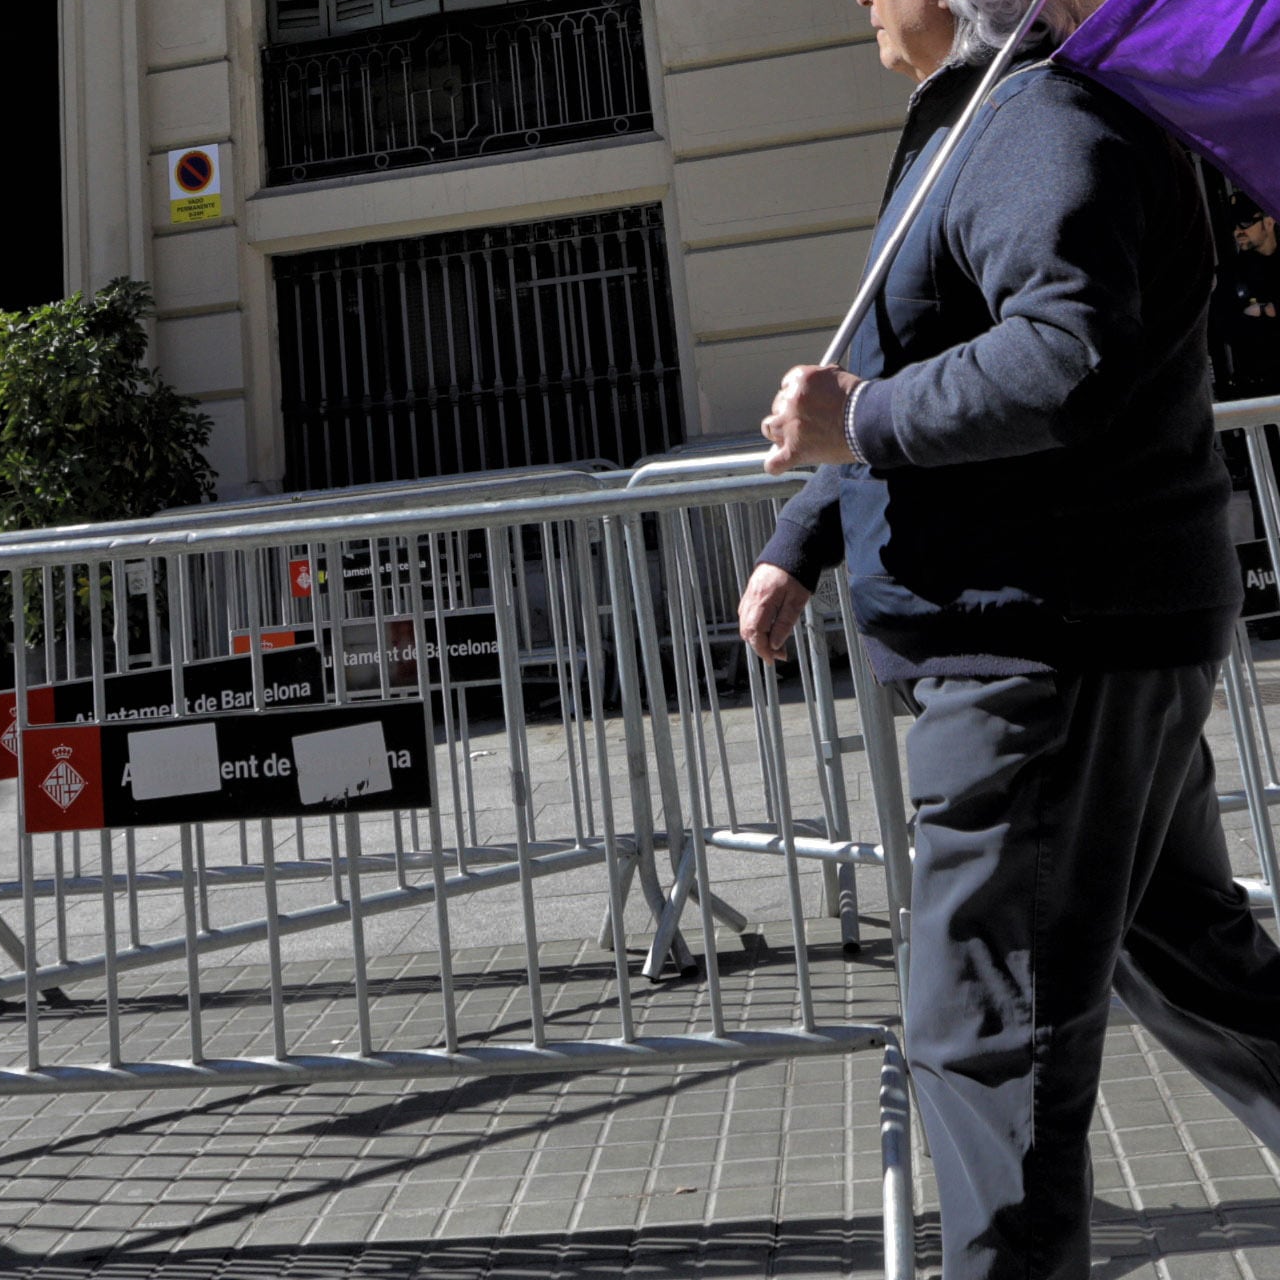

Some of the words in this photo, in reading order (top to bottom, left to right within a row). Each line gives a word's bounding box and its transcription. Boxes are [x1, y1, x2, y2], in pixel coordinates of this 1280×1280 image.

[194, 693, 217, 714] de
[220, 681, 312, 710] Barelona
[263, 752, 291, 778] de
